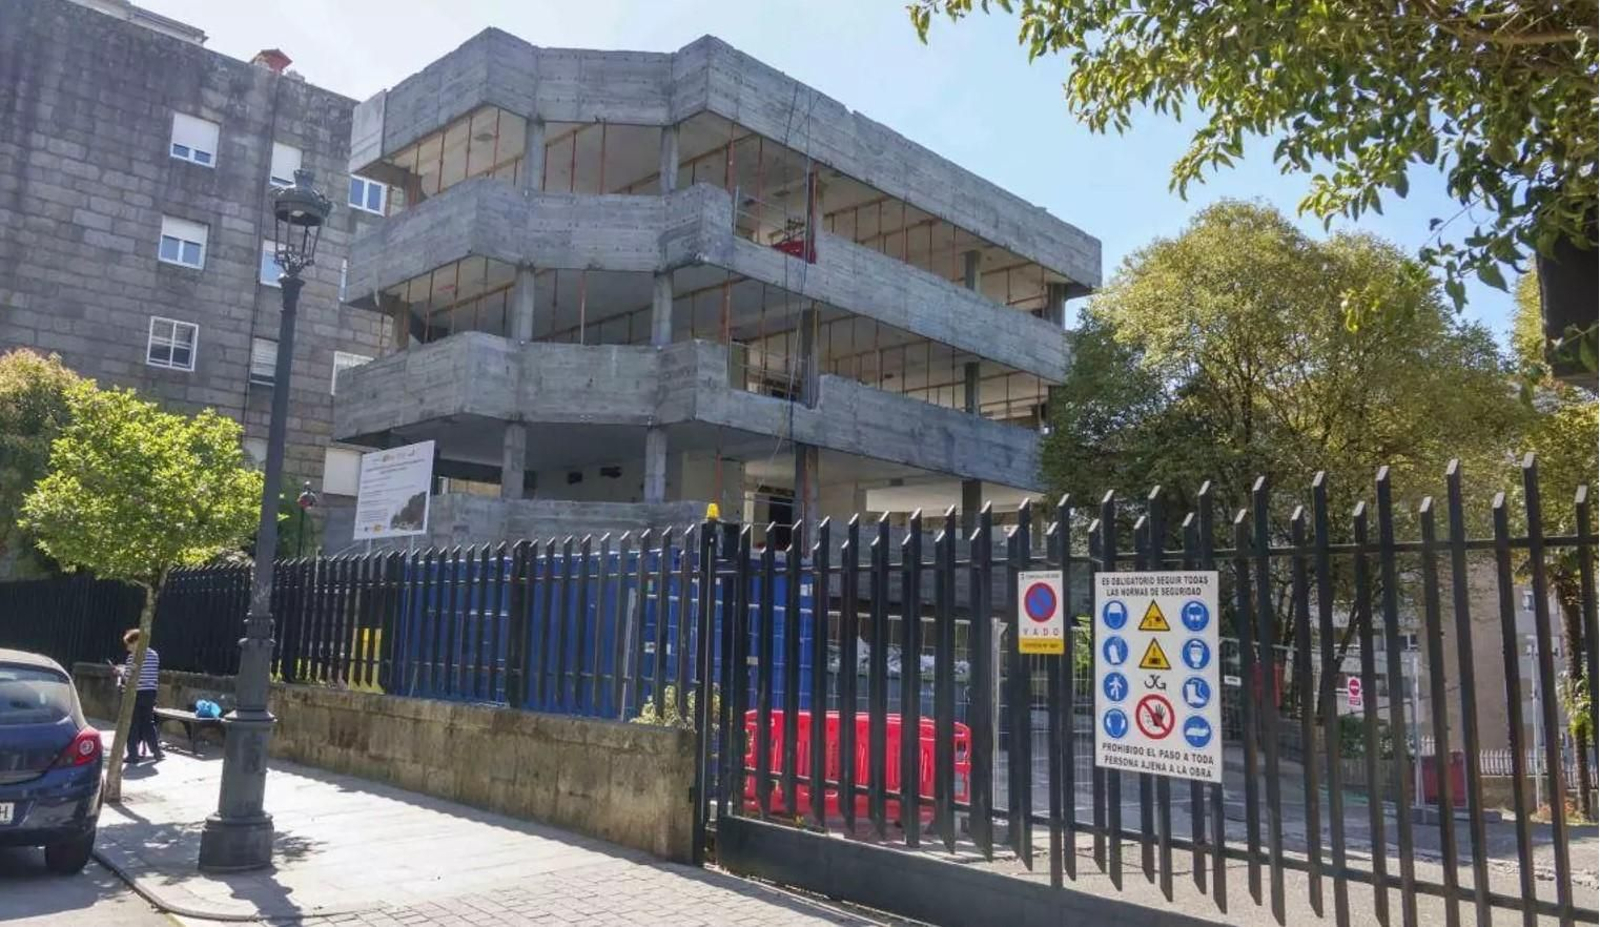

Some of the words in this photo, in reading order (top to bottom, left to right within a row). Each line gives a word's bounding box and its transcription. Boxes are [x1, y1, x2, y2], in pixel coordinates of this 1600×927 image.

[1102, 577, 1110, 585] ES
[1111, 576, 1155, 585] OBLIGATORIO
[1157, 576, 1182, 584] SEGUIR
[1184, 576, 1209, 585] TODAS
[1106, 588, 1119, 596] LAS
[1121, 587, 1149, 596] NORMAS
[1150, 587, 1159, 596] DE
[1161, 587, 1202, 596] SEGURIDAD
[1023, 627, 1060, 636] VADO
[1102, 742, 1144, 755] PROHIBIDO
[1146, 748, 1156, 757] EL
[1159, 749, 1180, 760] PASO
[1183, 753, 1189, 761] A
[1192, 753, 1214, 765] TODA
[1104, 755, 1138, 767] PERSONA
[1141, 760, 1167, 771] AJENA
[1169, 764, 1175, 772] A
[1176, 765, 1187, 774] LA
[1189, 767, 1212, 777] OBRA
